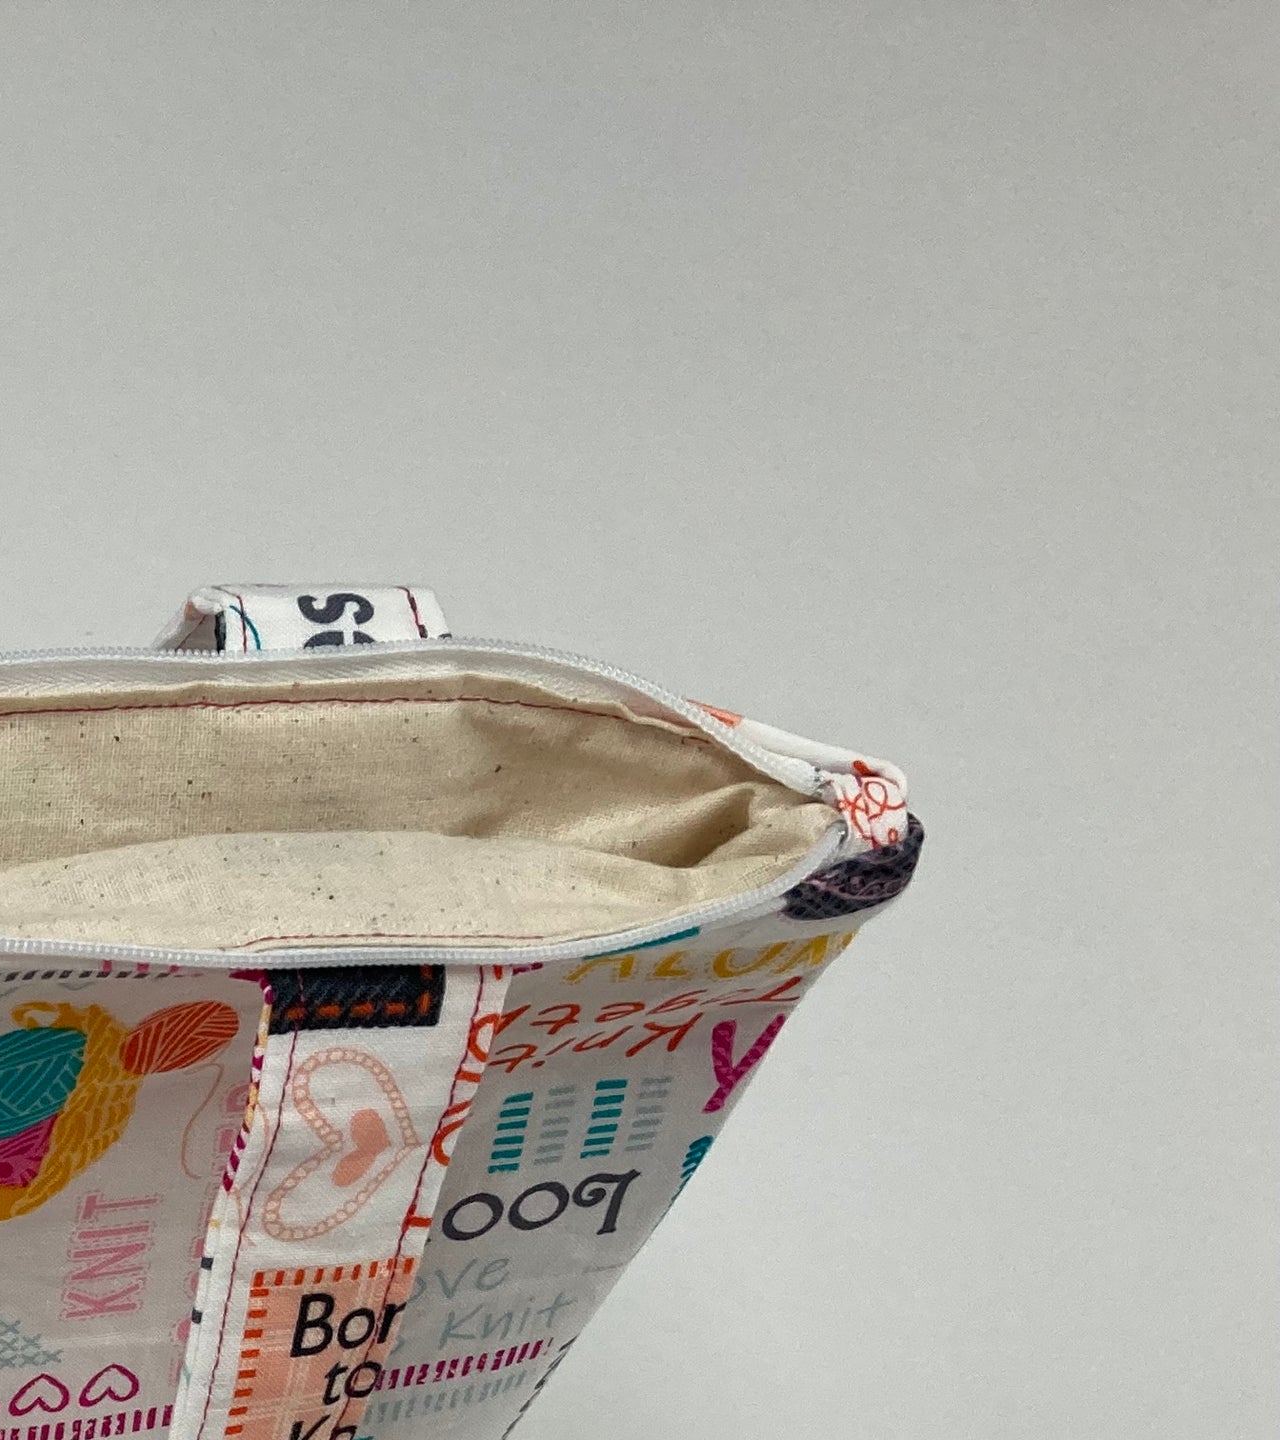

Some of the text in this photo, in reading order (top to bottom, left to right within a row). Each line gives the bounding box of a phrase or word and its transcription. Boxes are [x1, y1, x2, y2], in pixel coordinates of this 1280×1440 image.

[488, 1012, 704, 1073] Knit
[62, 1190, 164, 1321] KNIT
[441, 1291, 579, 1343] Knit
[323, 1361, 382, 1405] to
